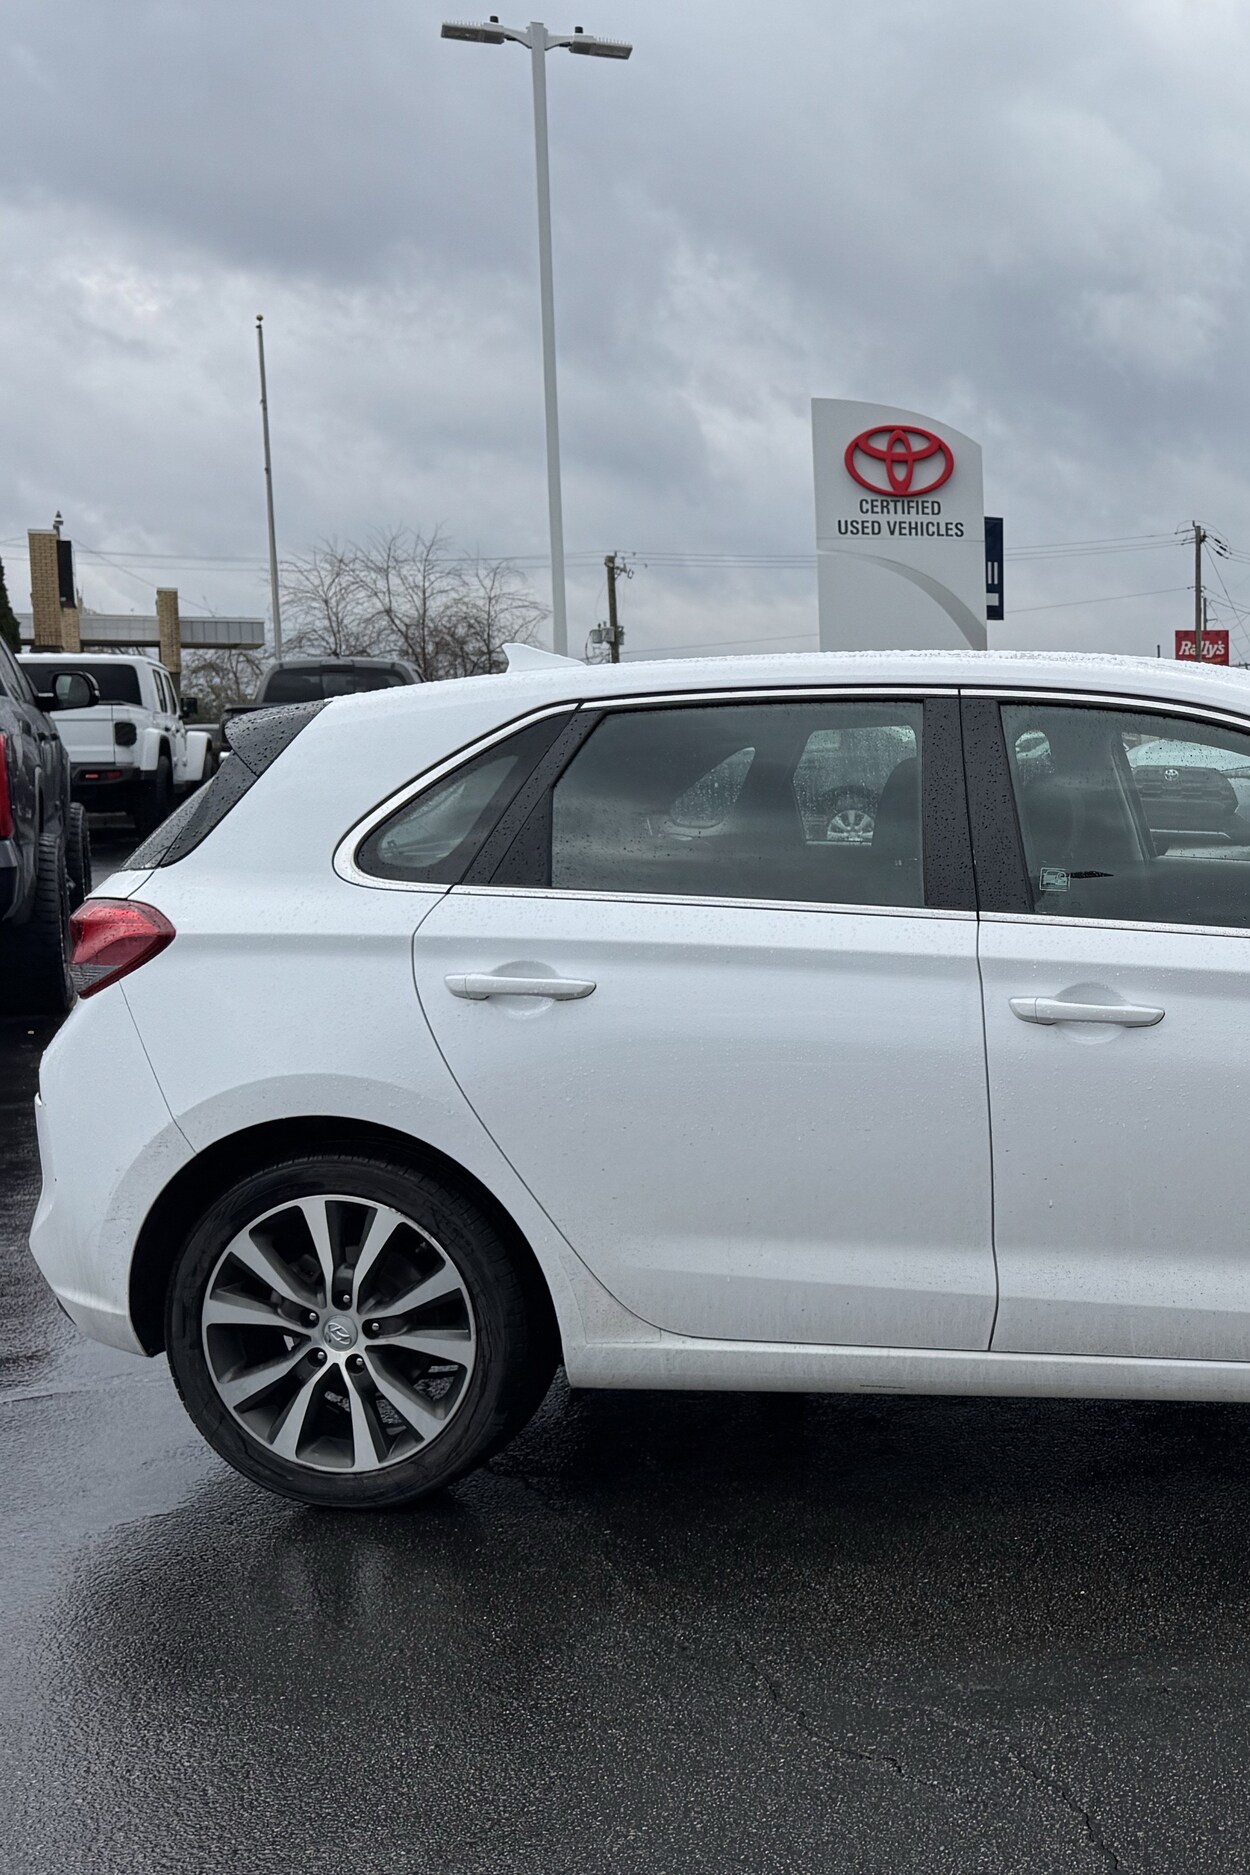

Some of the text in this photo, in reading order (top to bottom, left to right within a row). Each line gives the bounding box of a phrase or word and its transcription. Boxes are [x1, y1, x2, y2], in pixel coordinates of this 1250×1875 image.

[858, 498, 942, 516] CERTIFIED
[837, 519, 965, 538] USED VEHICLES
